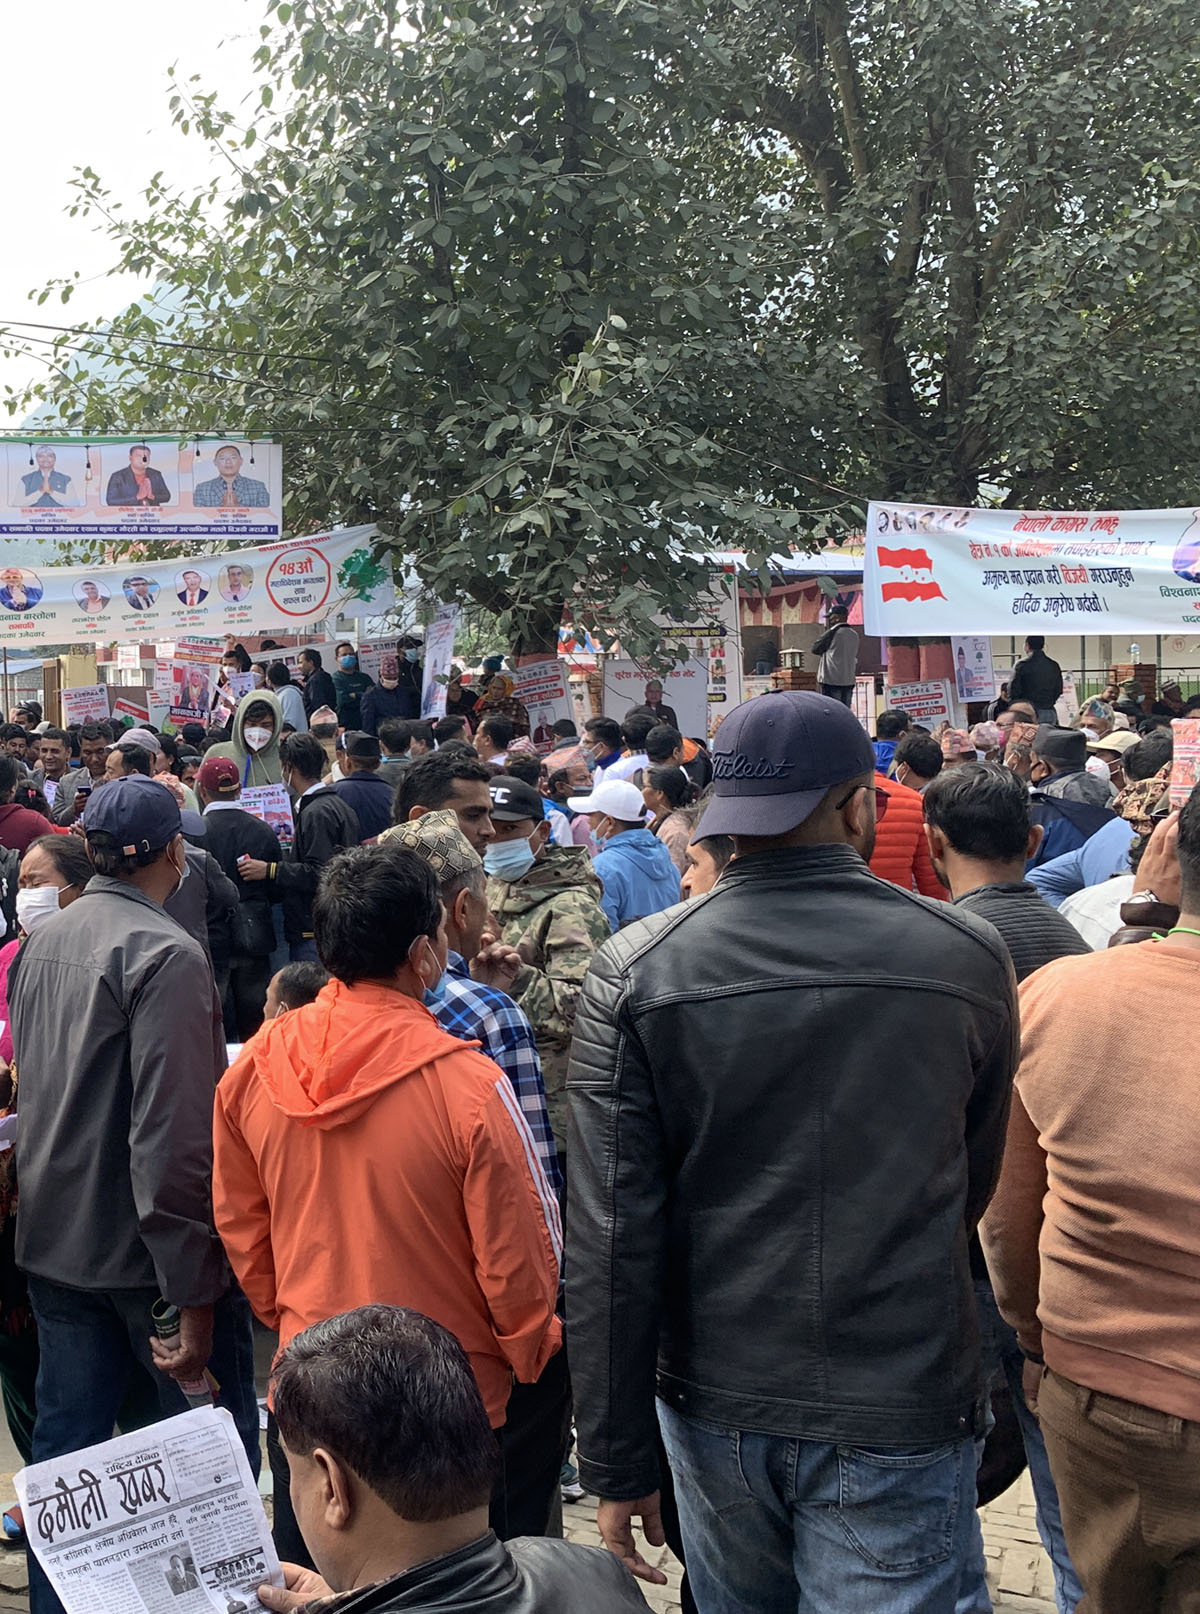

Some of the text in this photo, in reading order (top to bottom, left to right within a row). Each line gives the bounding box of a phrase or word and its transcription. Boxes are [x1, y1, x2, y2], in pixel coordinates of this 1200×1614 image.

[712, 750, 795, 780] Titleist
[28, 1459, 171, 1544] दमौली खबर
